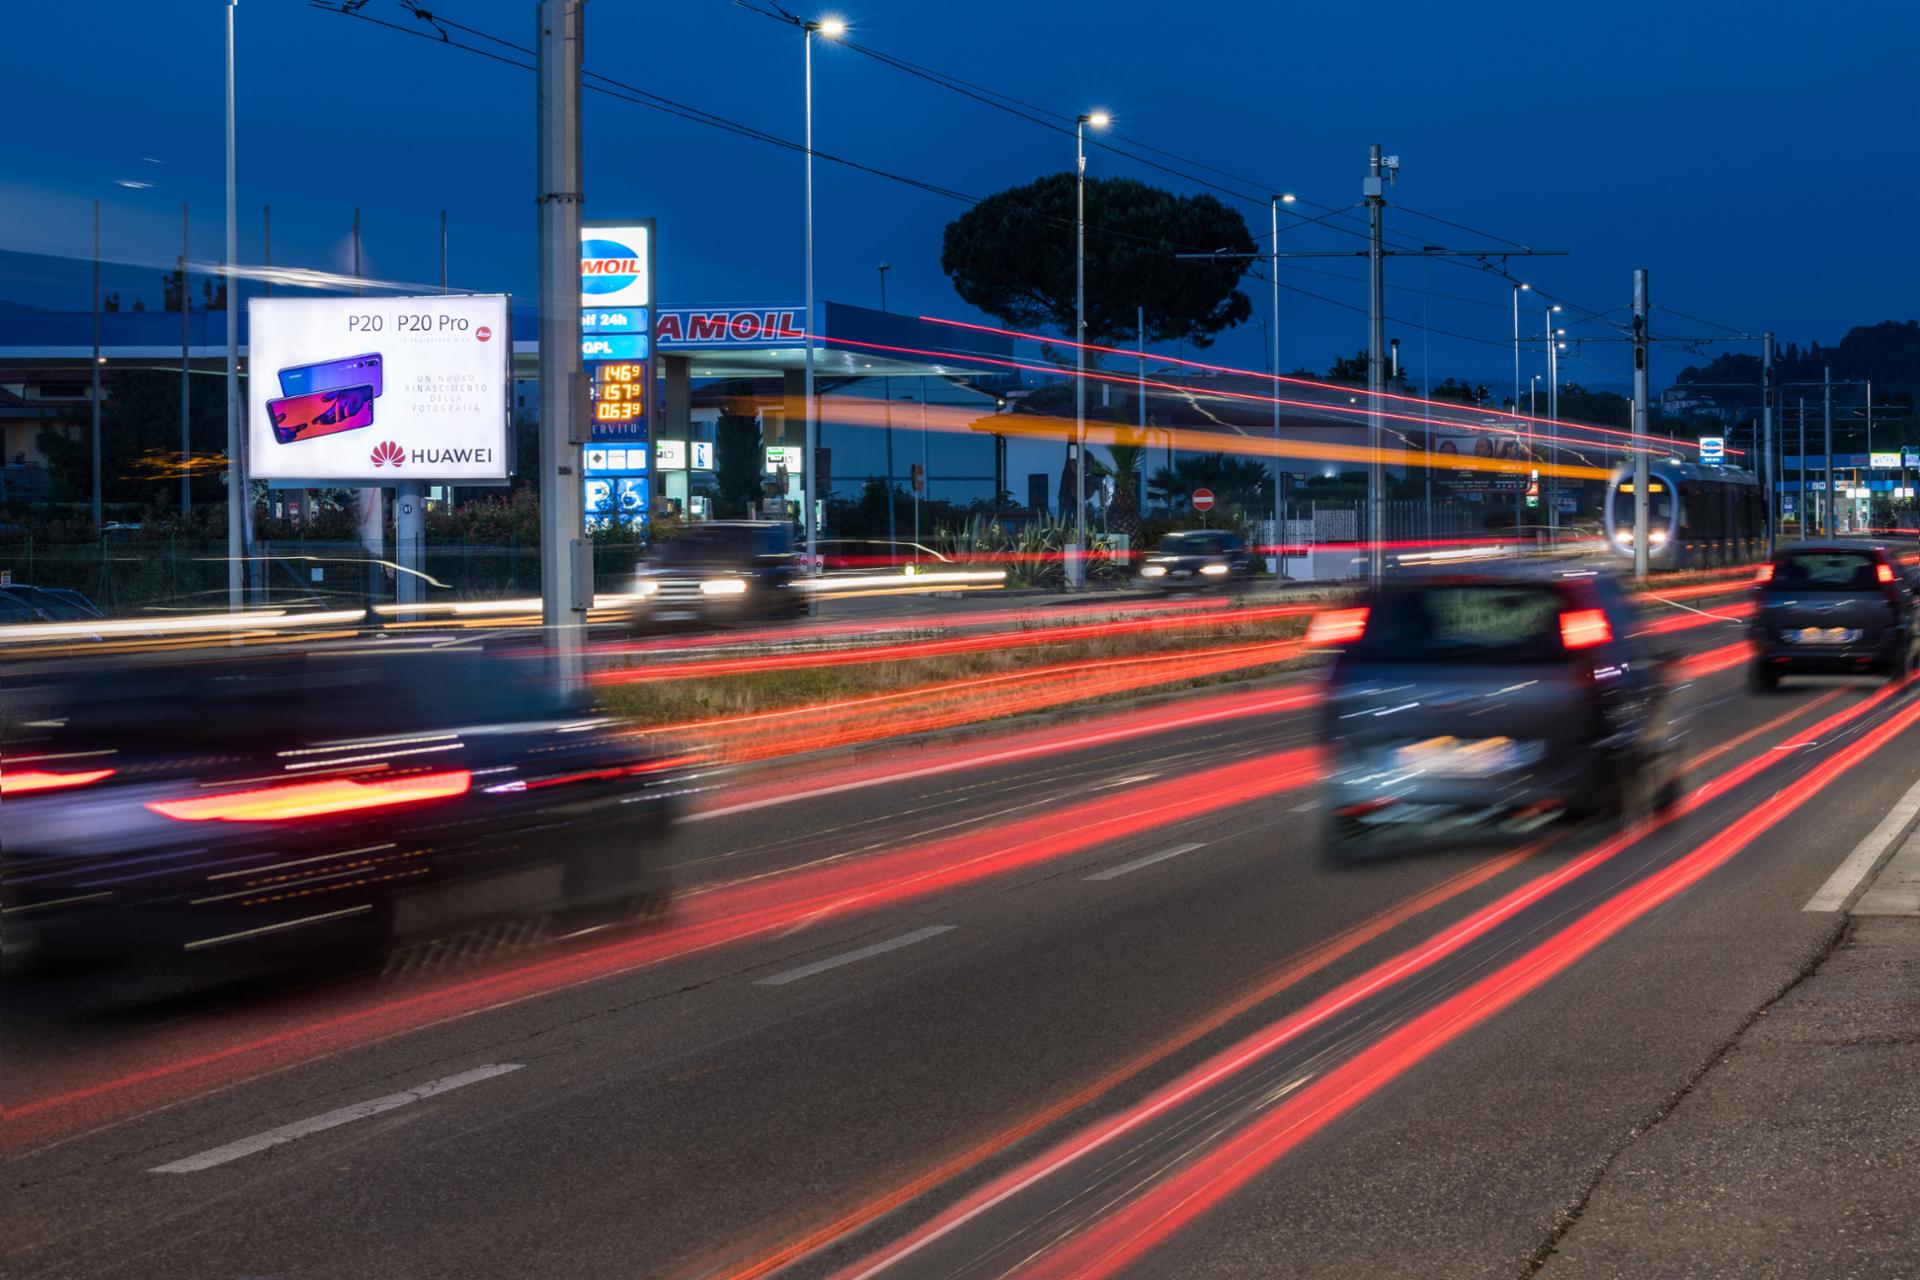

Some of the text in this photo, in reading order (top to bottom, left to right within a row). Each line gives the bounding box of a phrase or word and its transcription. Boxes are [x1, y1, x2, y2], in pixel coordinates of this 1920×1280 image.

[582, 259, 641, 274] MOIL
[349, 314, 469, 332] P20 P20 Pro
[600, 313, 628, 326] 24h
[656, 310, 806, 342] AMOIL
[417, 374, 474, 383] UN NUOVO
[404, 383, 487, 393] RINASCIMENTO
[429, 394, 462, 402] DELLA
[412, 404, 480, 413] FOTOGRAFIA
[592, 423, 638, 435] ERVITO
[411, 448, 492, 463] HUAWEI
